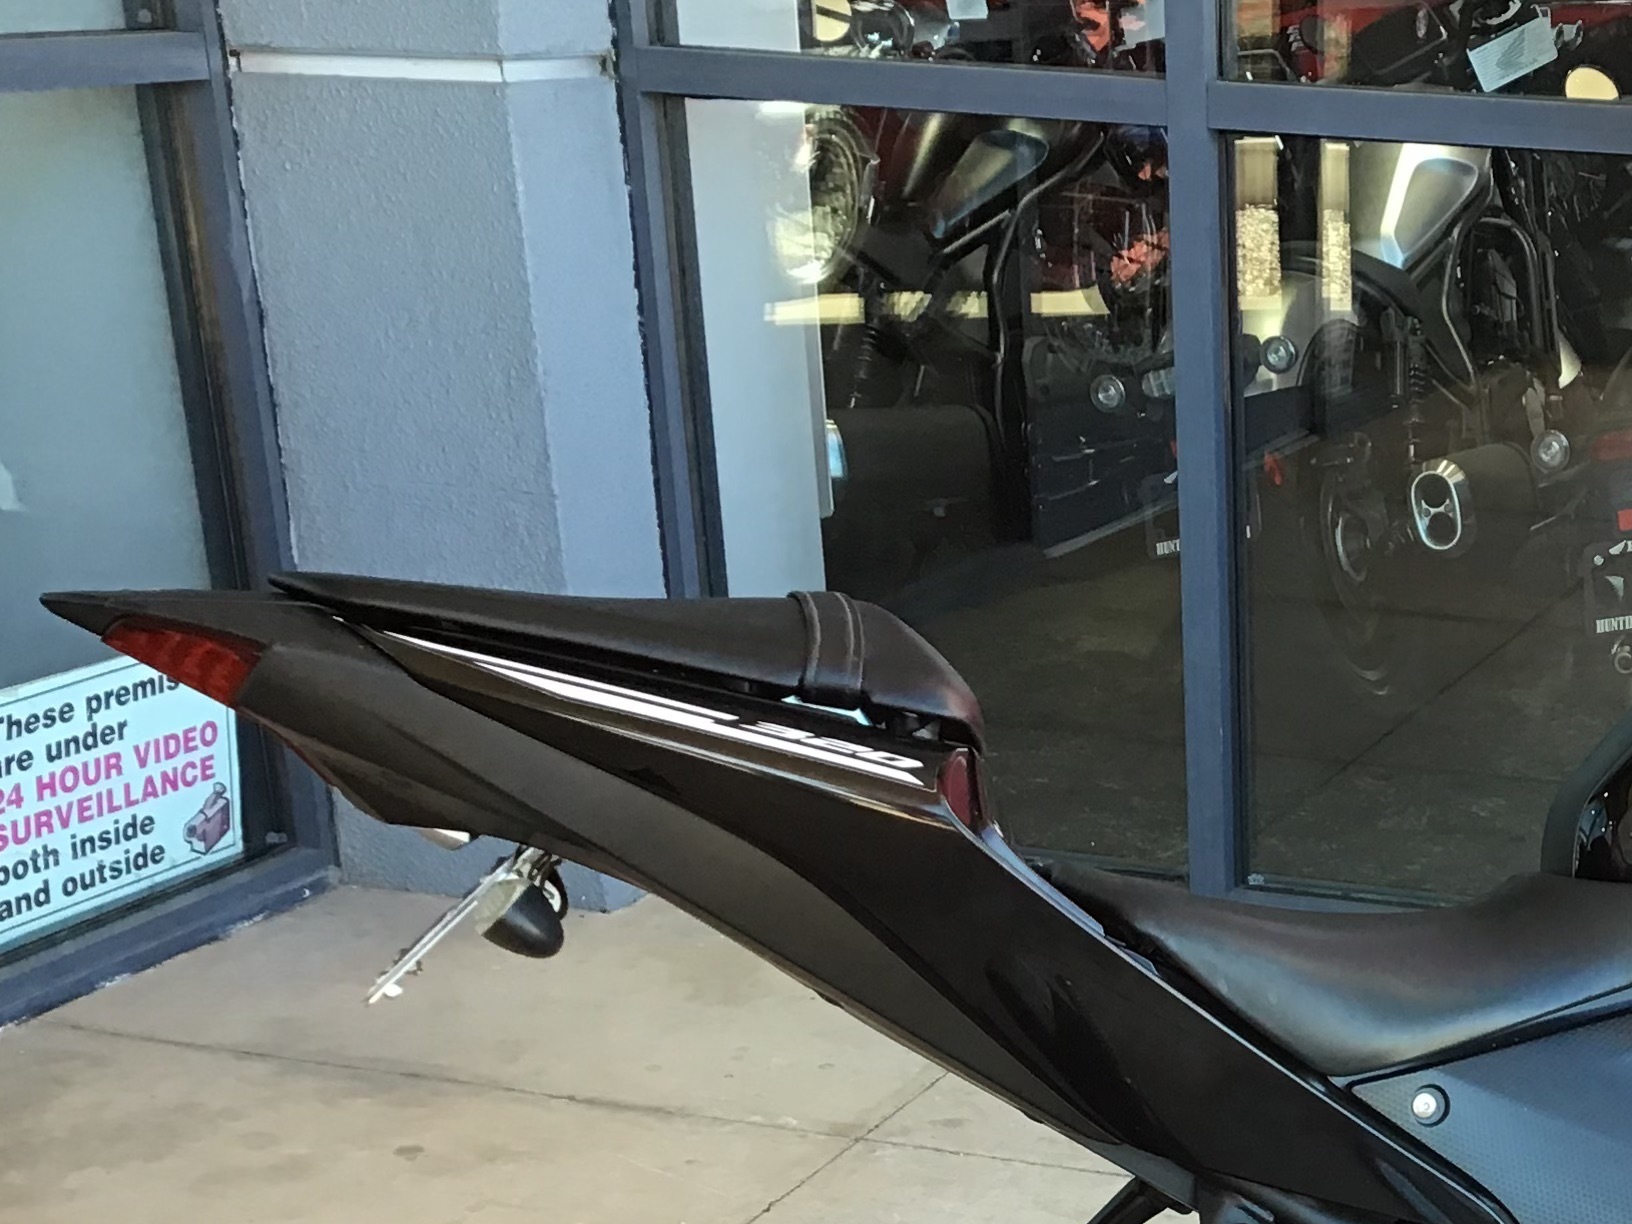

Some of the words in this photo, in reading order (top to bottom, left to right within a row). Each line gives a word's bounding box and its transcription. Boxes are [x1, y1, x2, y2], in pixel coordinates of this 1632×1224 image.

[0, 750, 34, 778] re
[45, 719, 128, 762] under
[36, 751, 123, 801] HOUR
[133, 720, 218, 769] VIDEO
[0, 755, 216, 851] SURVEILLANCE
[70, 813, 155, 860] inside
[0, 879, 51, 921] and
[62, 844, 165, 897] outside
